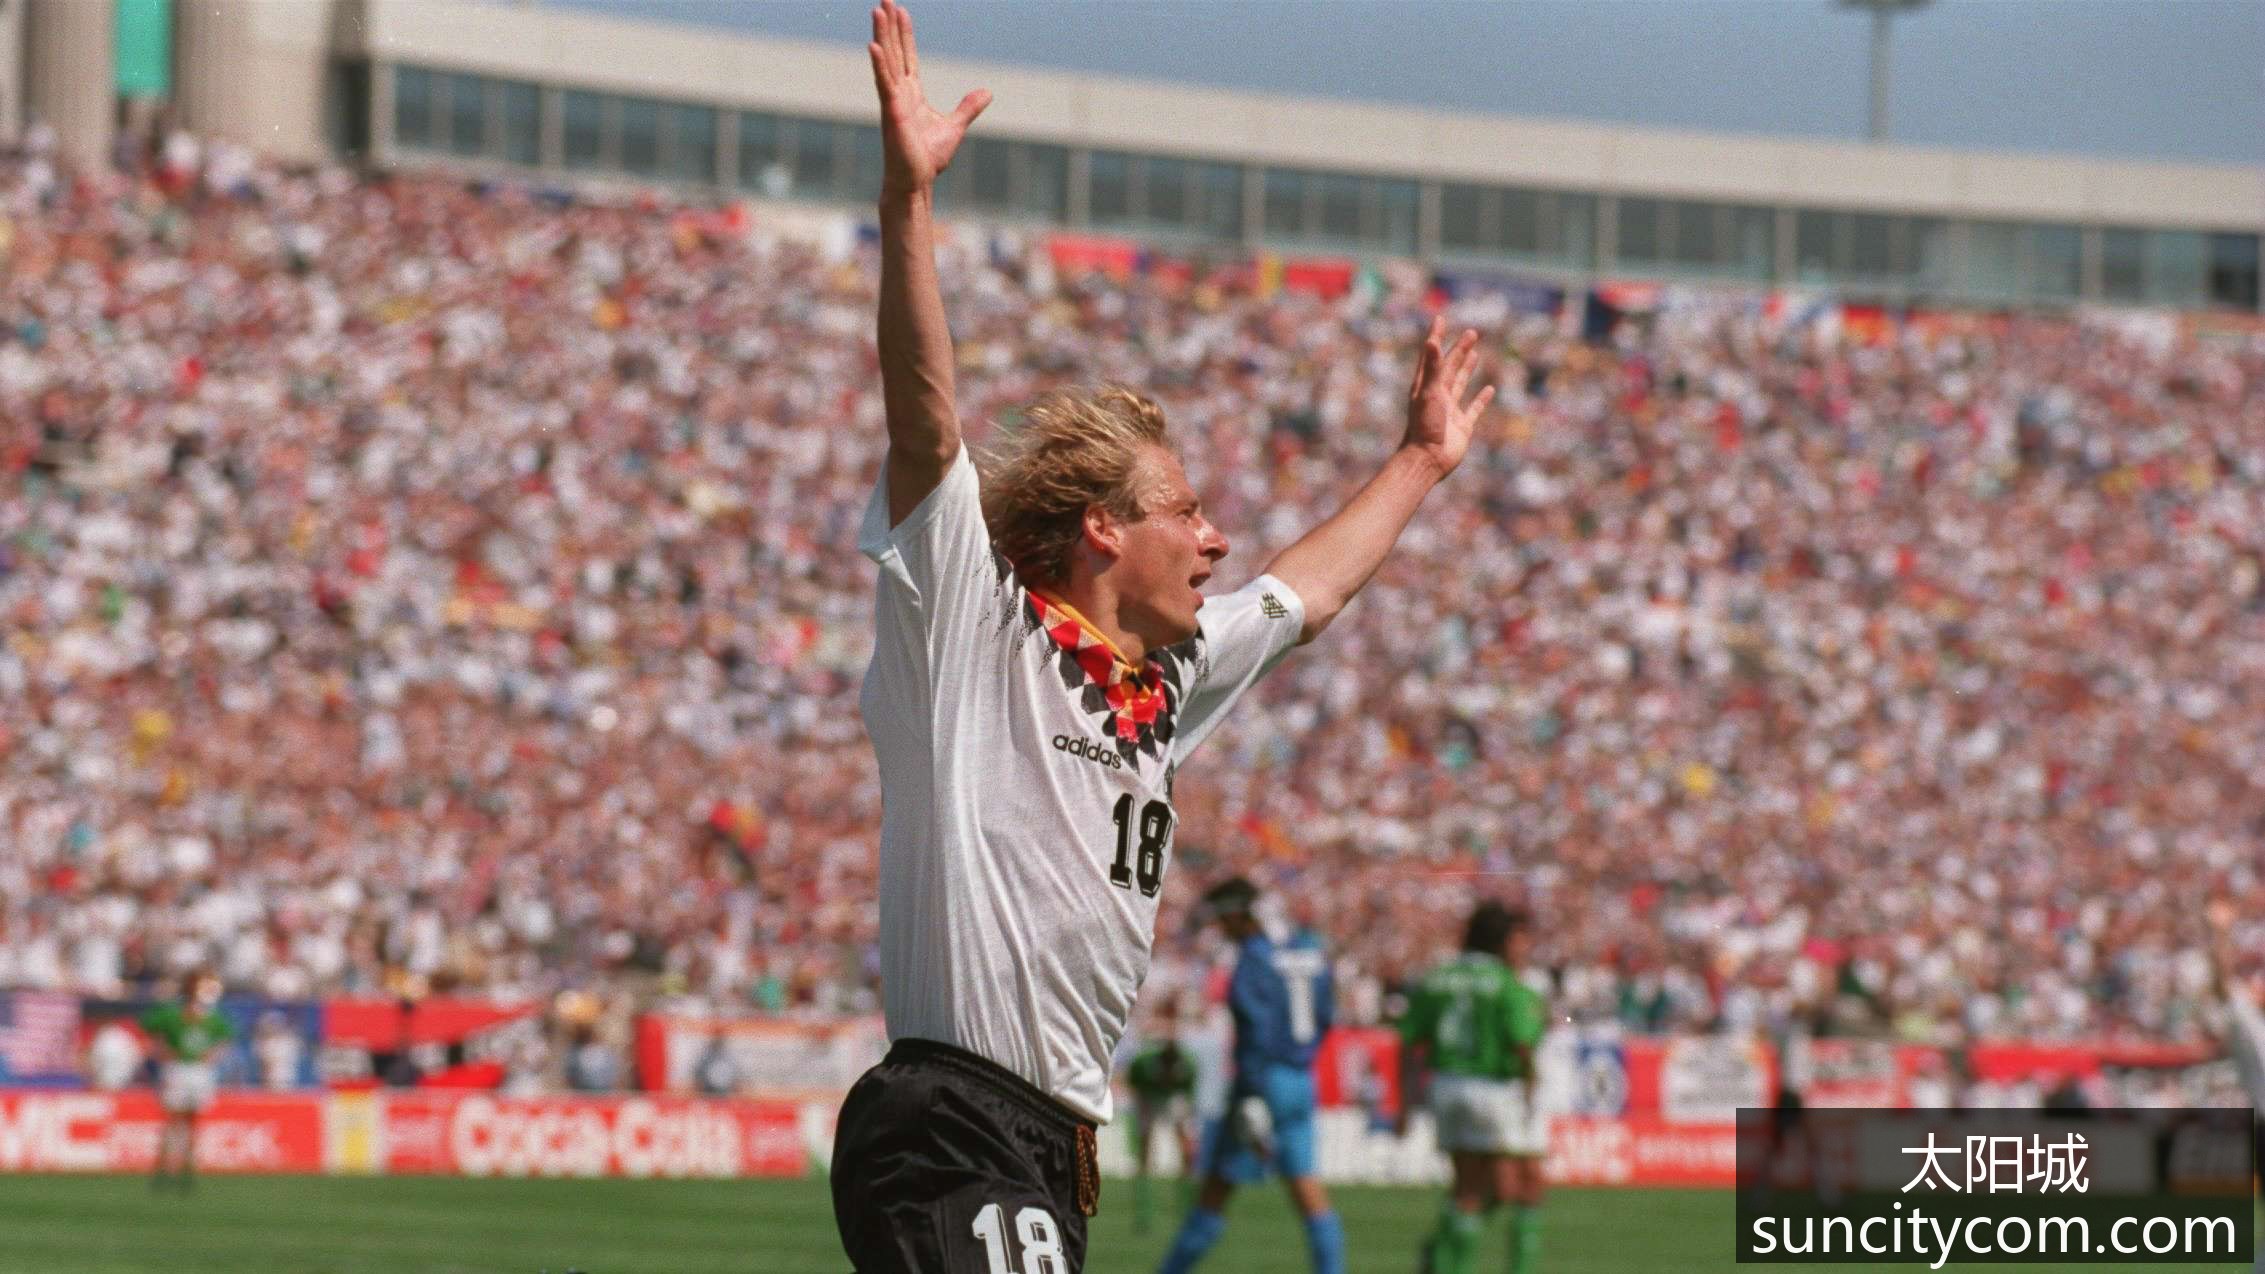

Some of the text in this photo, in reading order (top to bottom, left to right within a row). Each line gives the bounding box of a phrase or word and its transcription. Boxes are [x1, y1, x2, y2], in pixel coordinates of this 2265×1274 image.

[1052, 733, 1121, 769] adidas
[1110, 793, 1172, 898] 18
[455, 1098, 740, 1177] Coca-Cola
[972, 1203, 1069, 1274] 18
